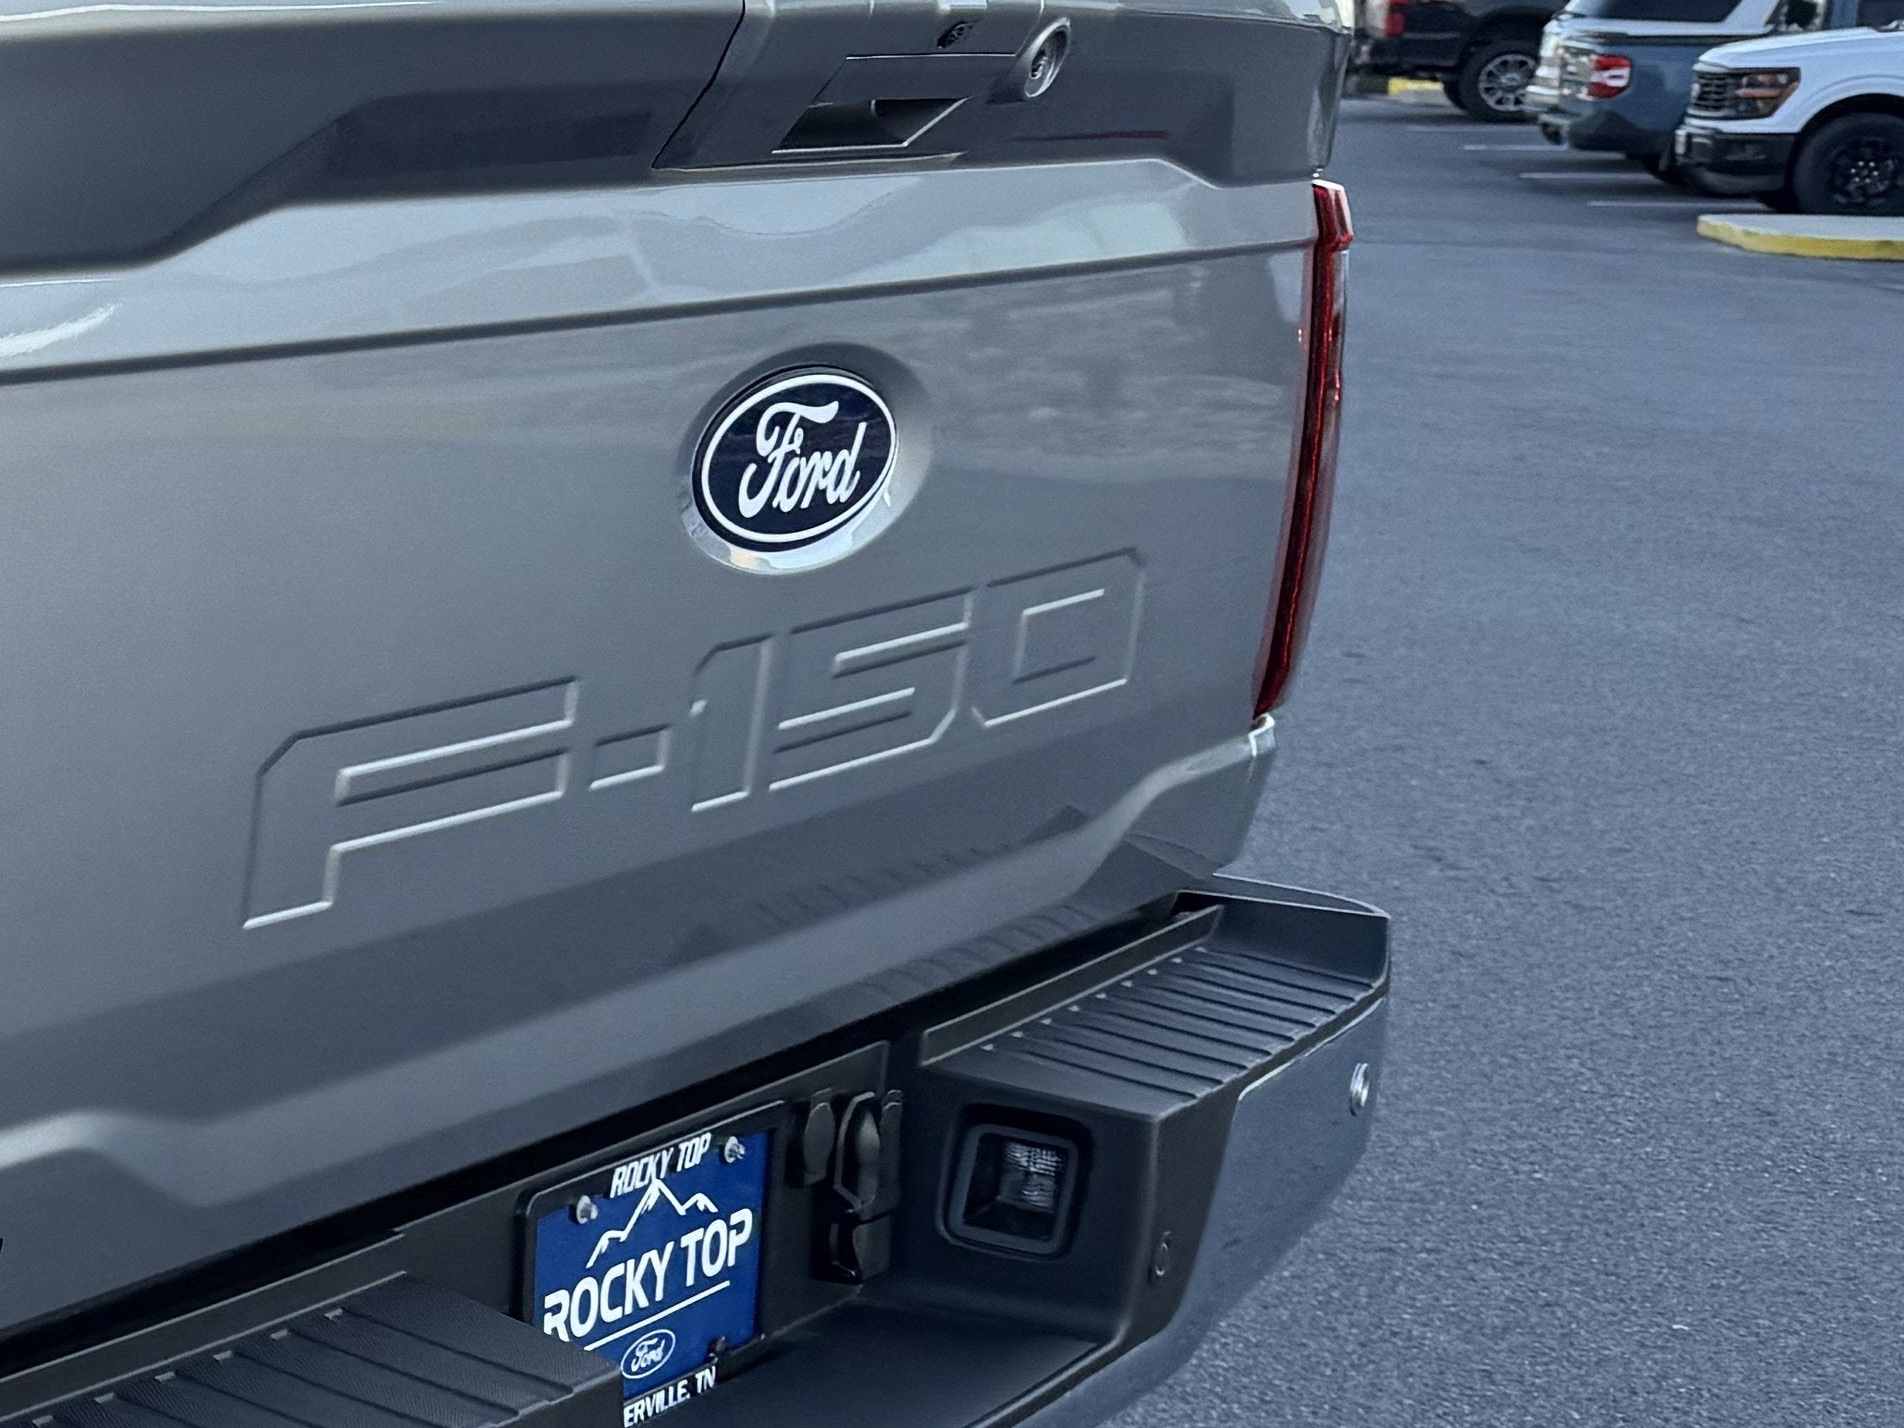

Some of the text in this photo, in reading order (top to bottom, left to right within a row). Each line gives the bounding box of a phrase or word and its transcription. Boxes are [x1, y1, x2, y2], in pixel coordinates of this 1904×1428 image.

[738, 400, 868, 519] Ford
[242, 545, 1149, 929] F-150
[609, 1132, 712, 1199] ROCKY TOP
[544, 1208, 753, 1342] ROCKY TOP
[630, 1337, 666, 1373] Ford
[694, 1365, 717, 1394] TN
